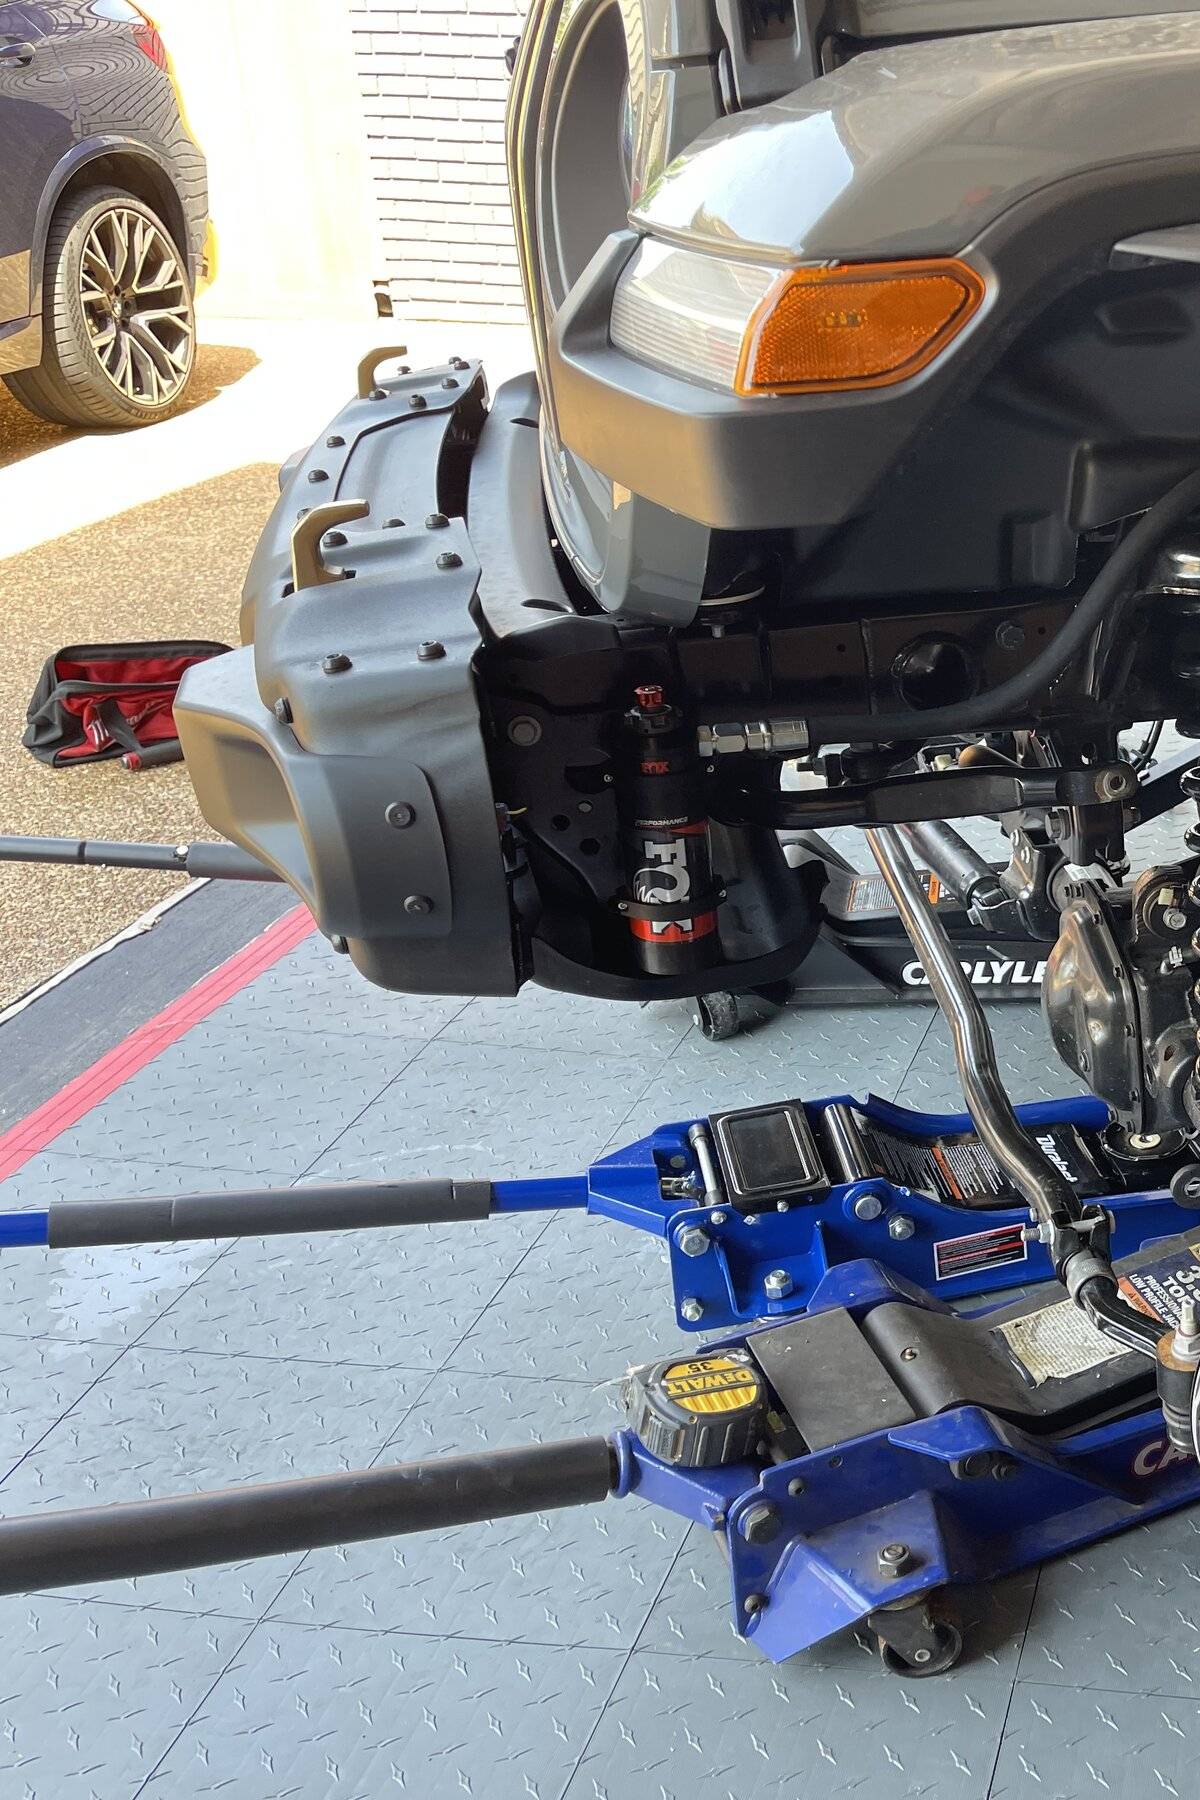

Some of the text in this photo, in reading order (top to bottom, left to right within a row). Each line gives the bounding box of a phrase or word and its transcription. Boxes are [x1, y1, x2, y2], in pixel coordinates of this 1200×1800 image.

[902, 960, 1050, 985] CLYLE
[1036, 1134, 1077, 1183] Duralast
[1129, 1274, 1146, 1293] LOW
[1141, 1284, 1168, 1315] PROFILE
[1143, 1275, 1183, 1321] PROFESSIONA
